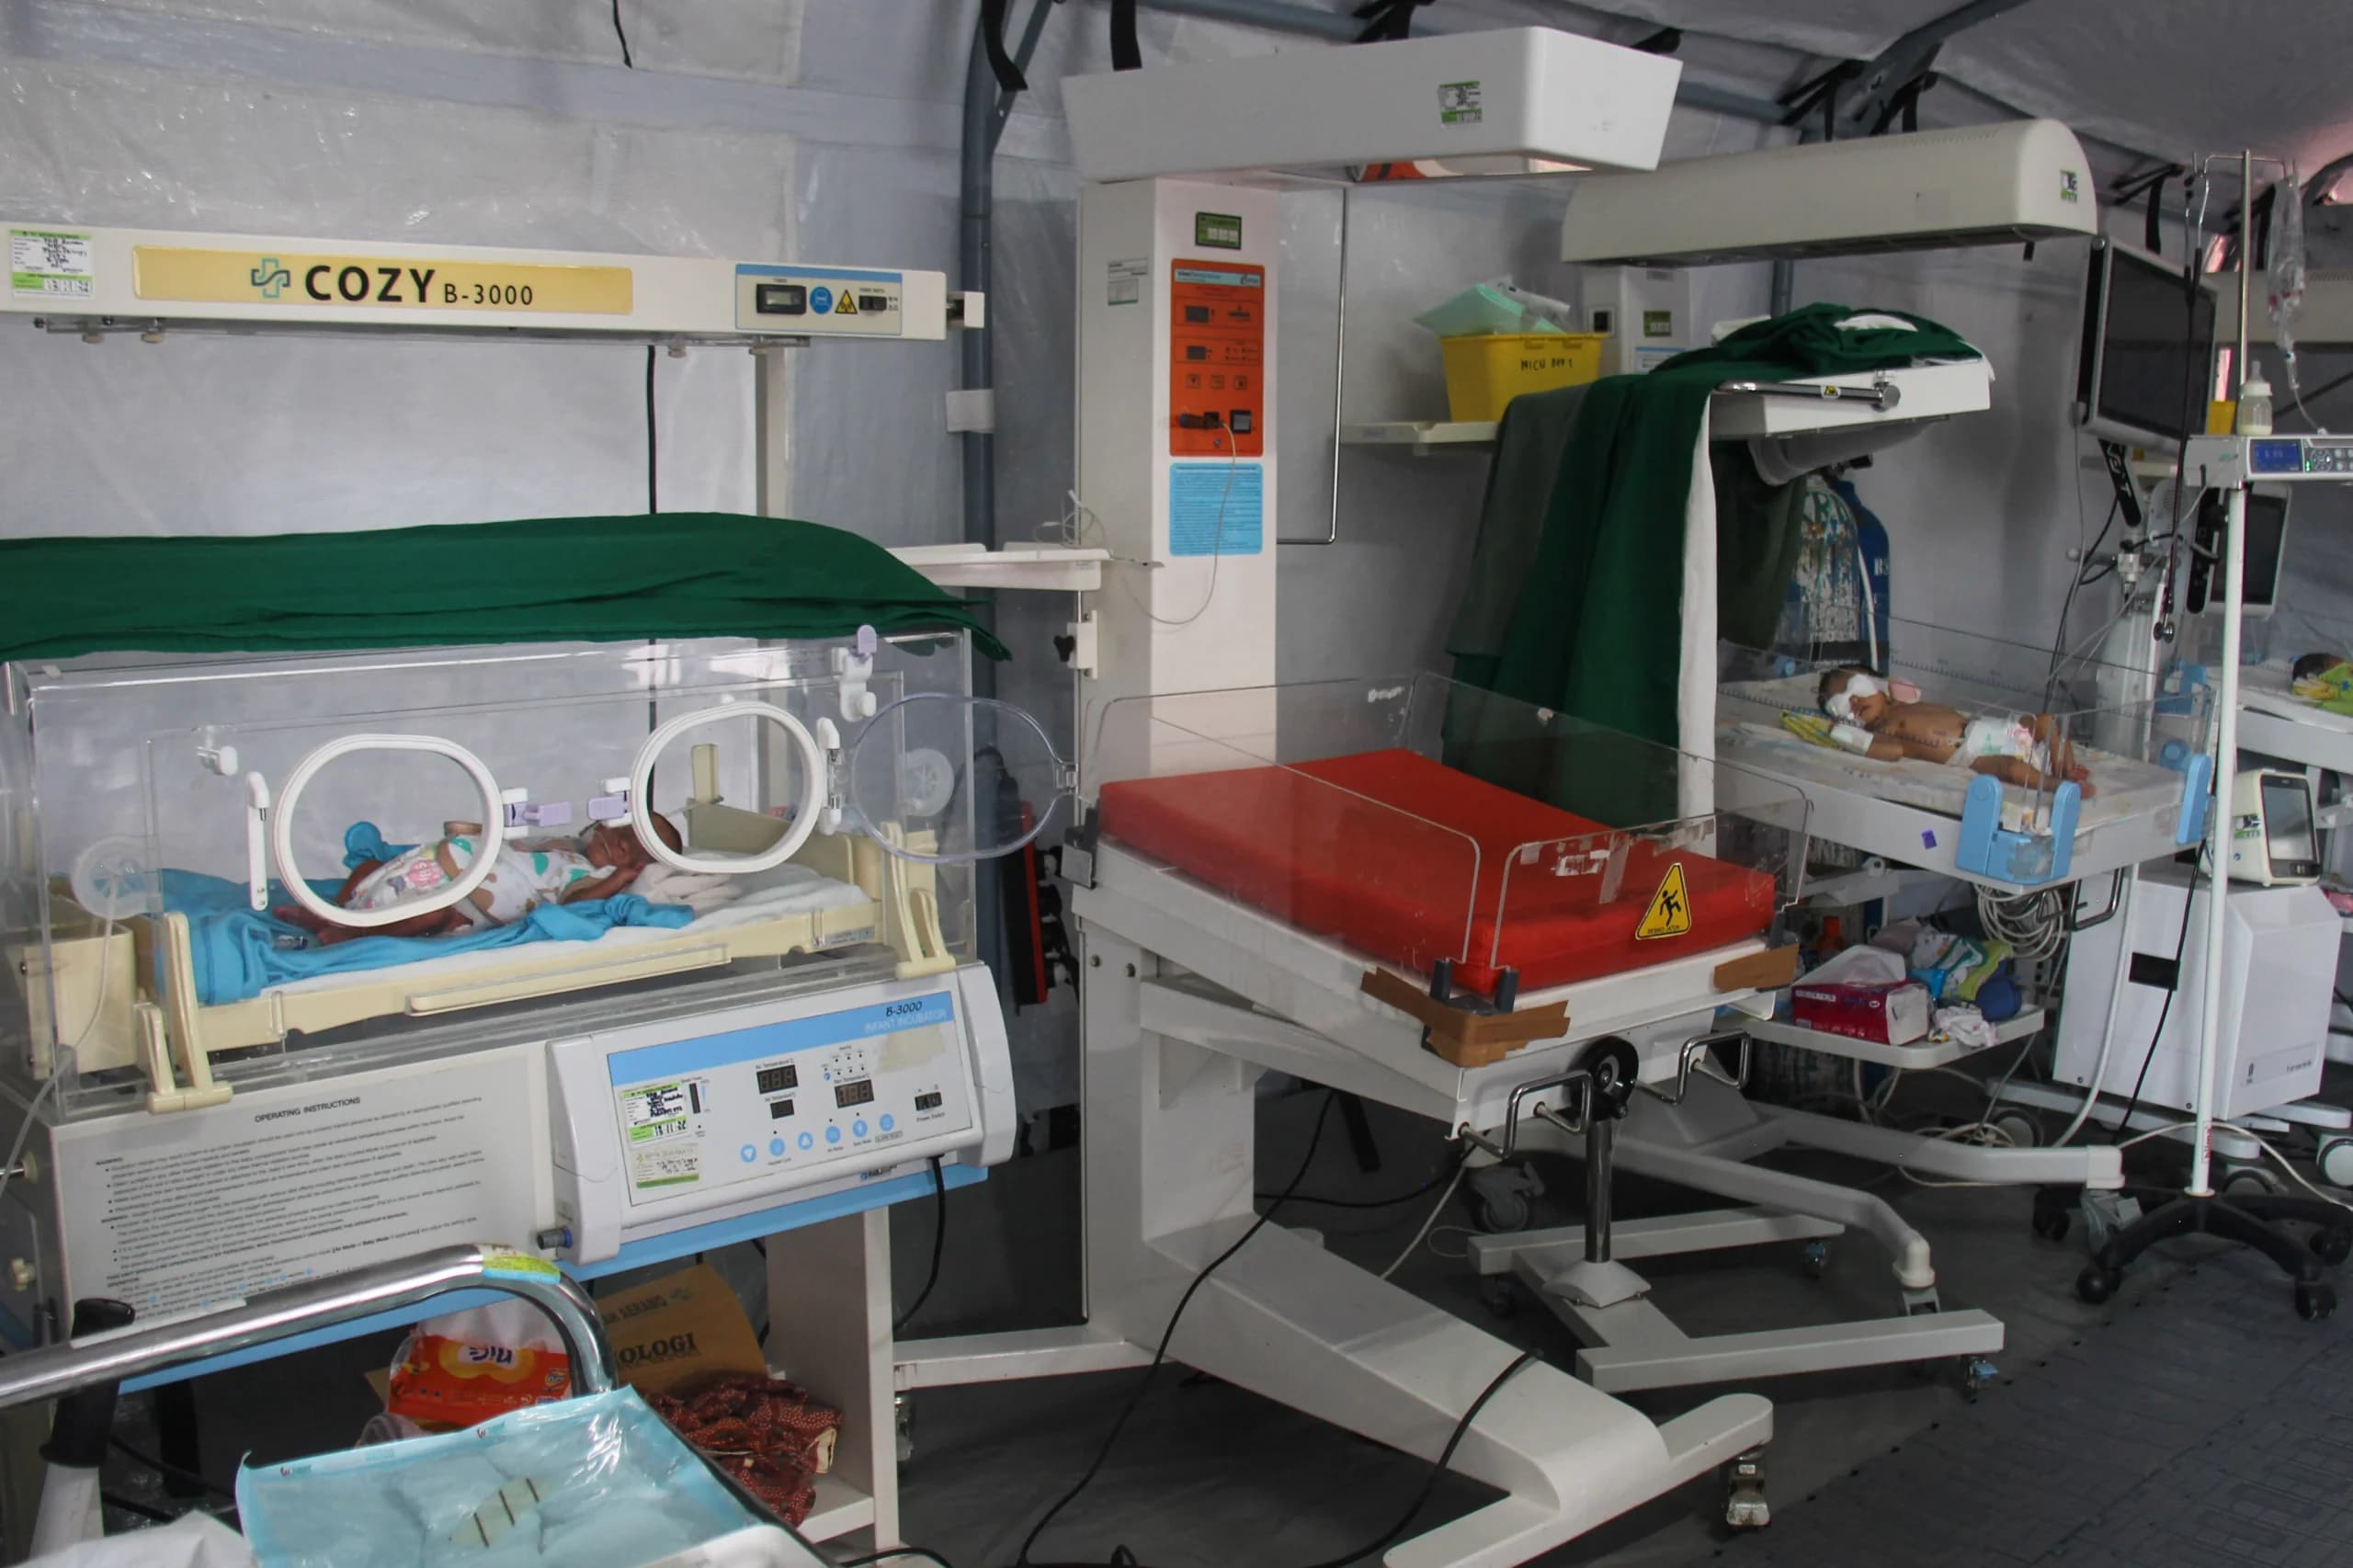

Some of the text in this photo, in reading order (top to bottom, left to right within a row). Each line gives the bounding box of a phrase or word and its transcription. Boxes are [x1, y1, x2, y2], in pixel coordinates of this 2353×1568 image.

[304, 265, 534, 306] COZY B-3000
[886, 1001, 923, 1017] B-3000
[255, 1096, 360, 1122] OPERATING INSTRUCTIONS
[615, 1332, 699, 1365] OLOGI
